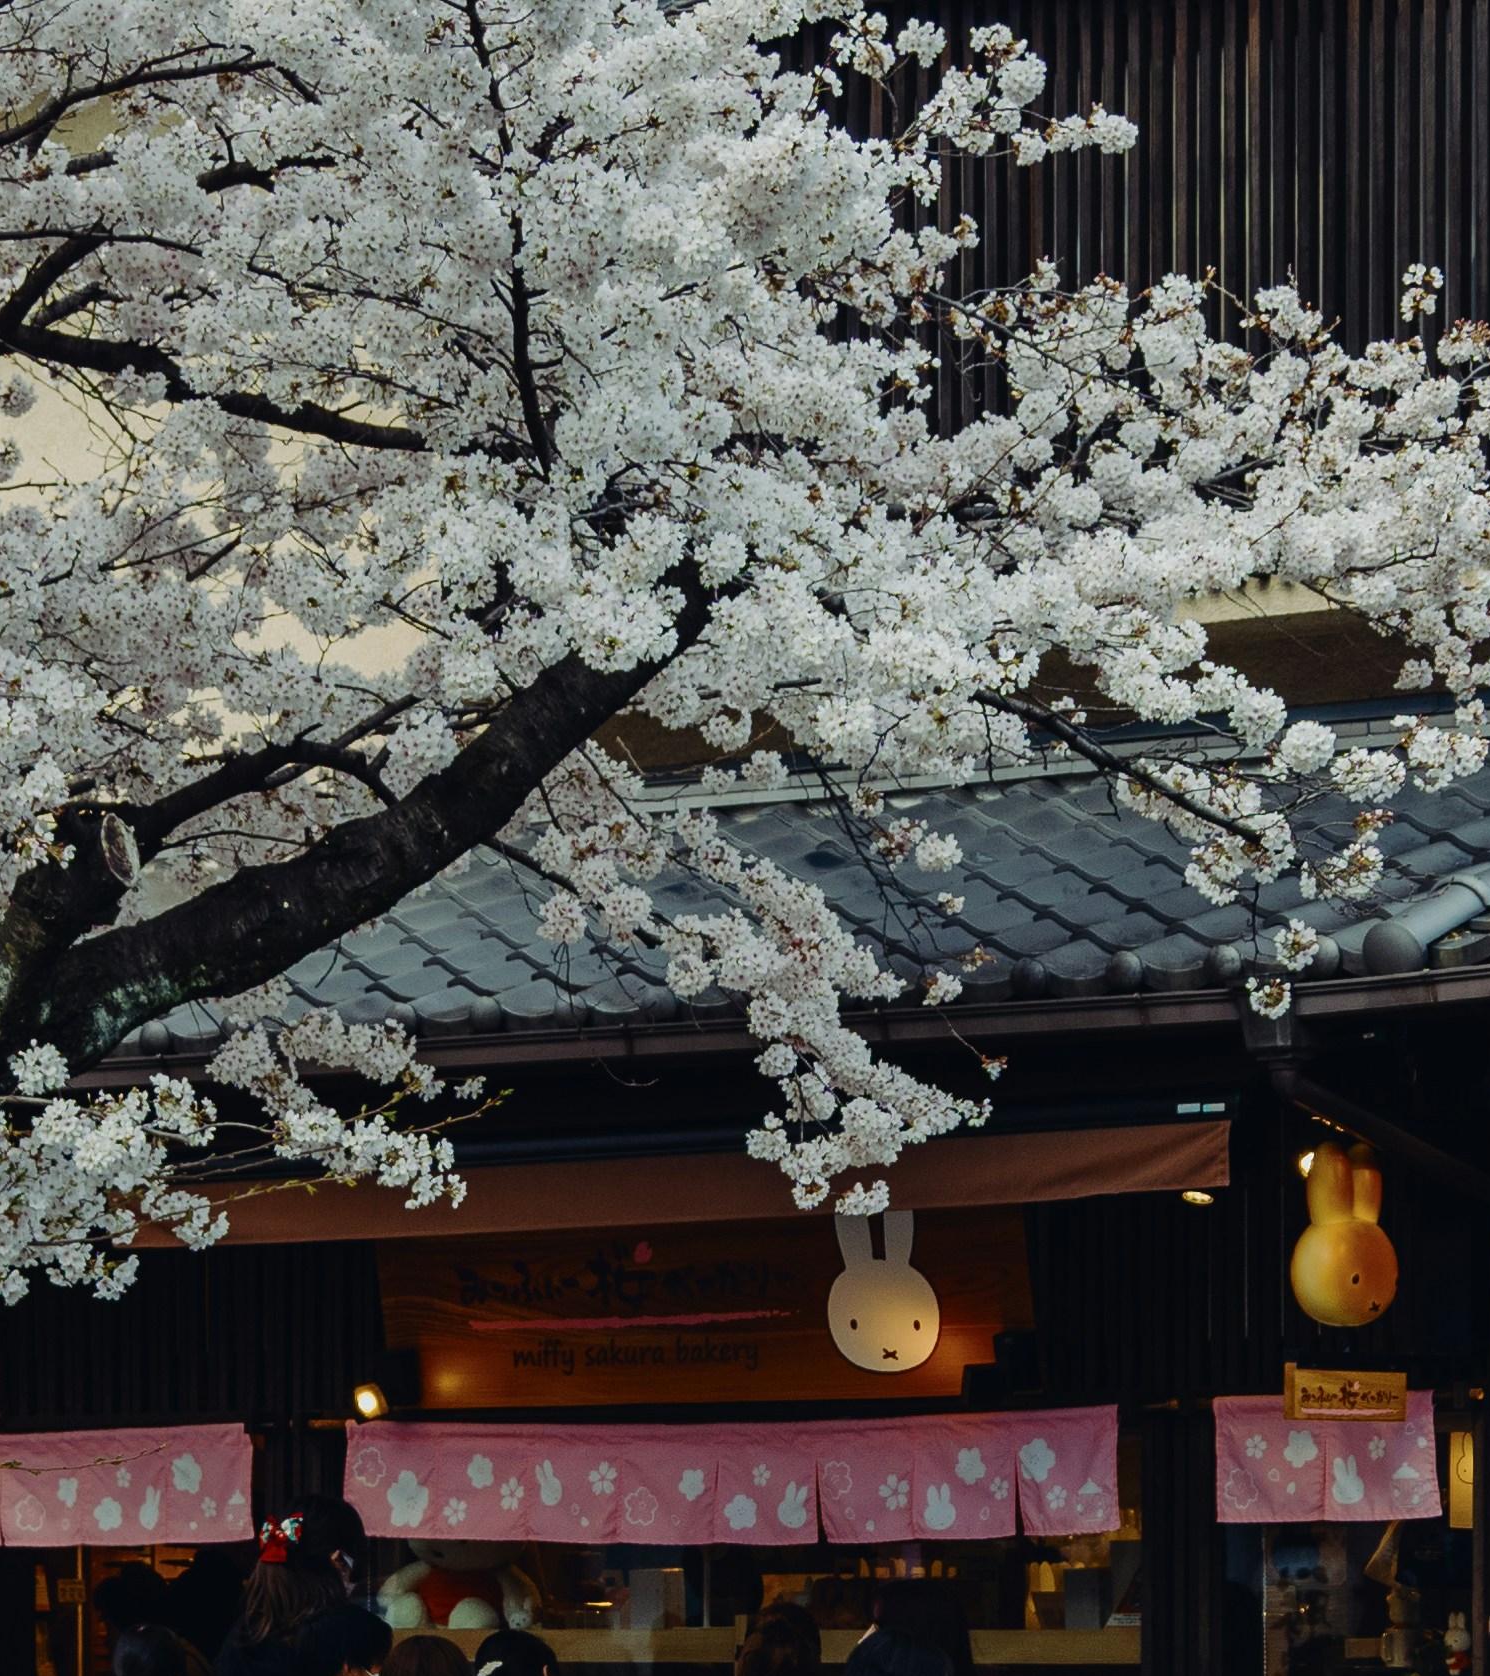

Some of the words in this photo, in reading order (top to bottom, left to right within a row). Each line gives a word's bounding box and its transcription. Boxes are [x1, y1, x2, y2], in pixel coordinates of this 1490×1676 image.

[513, 1339, 575, 1376] miffy
[583, 1337, 666, 1367] sakura
[675, 1334, 761, 1372] bakery
